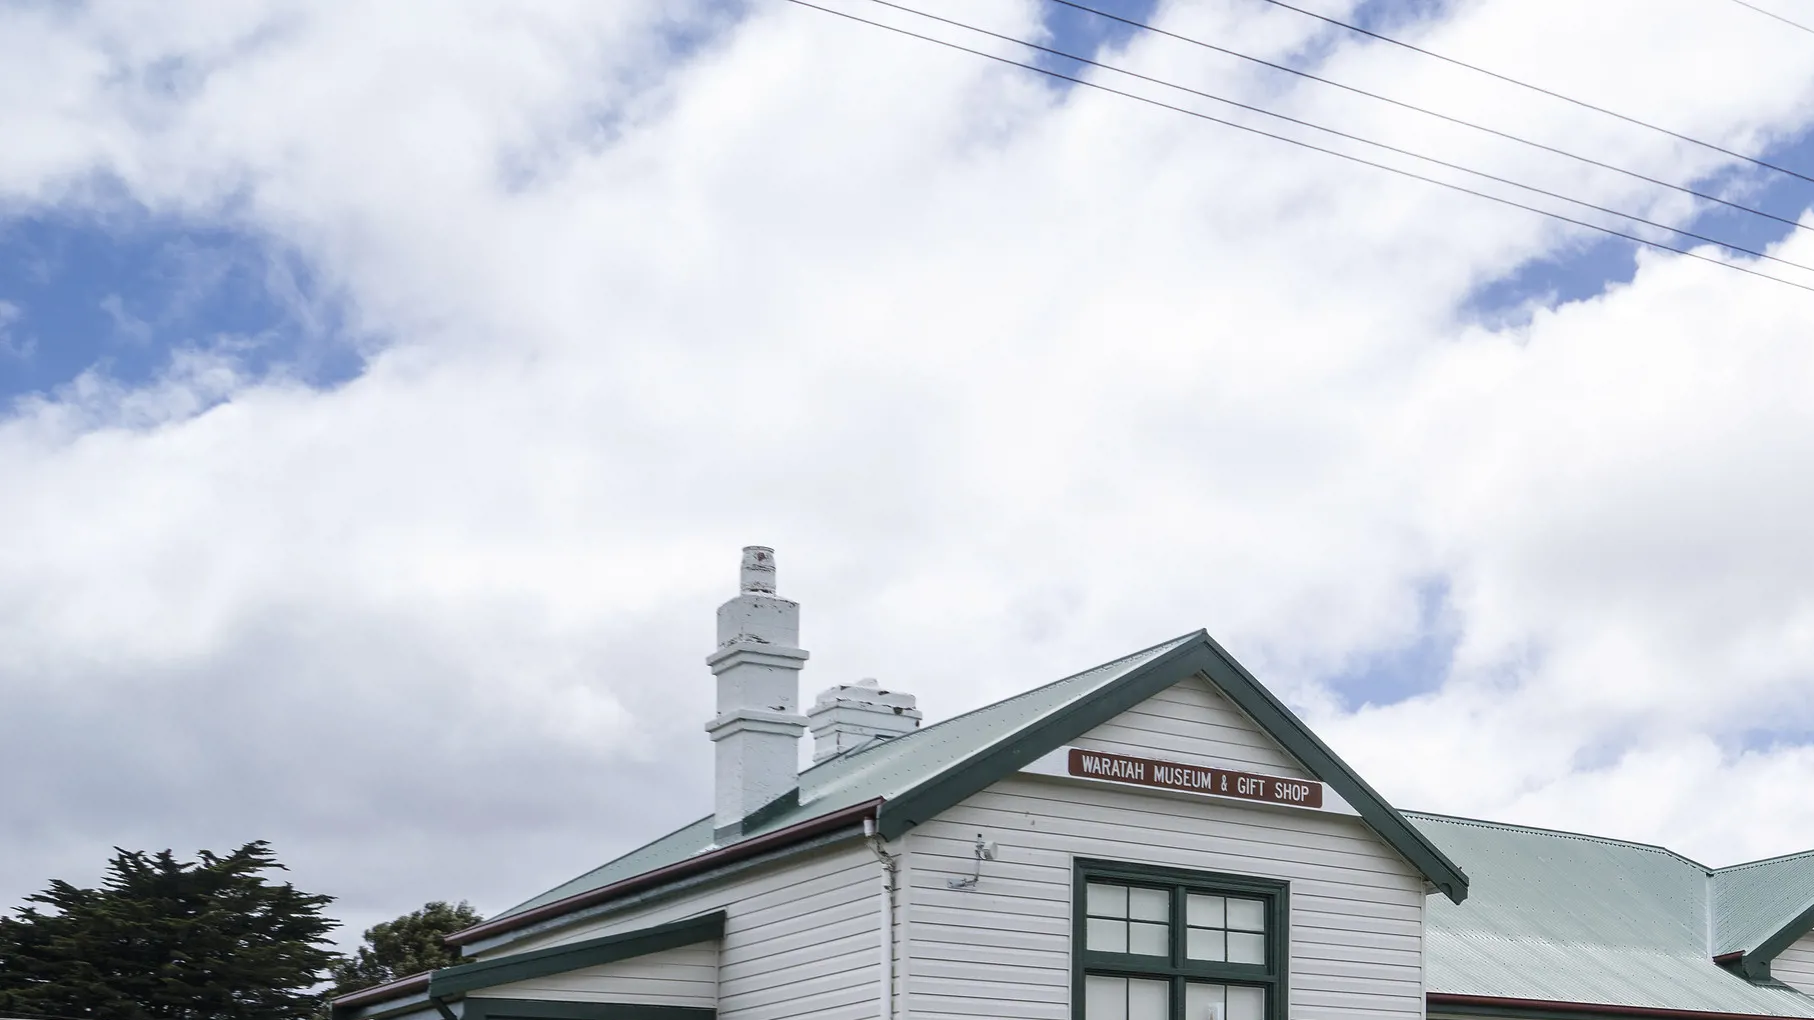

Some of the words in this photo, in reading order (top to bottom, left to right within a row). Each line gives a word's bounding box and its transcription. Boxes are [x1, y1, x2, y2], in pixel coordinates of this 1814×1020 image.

[1082, 754, 1144, 780] WARATAH
[1153, 765, 1212, 790] MUSEUM
[1220, 775, 1228, 792] &
[1237, 776, 1266, 797] GIFT
[1274, 782, 1310, 802] SHOP
